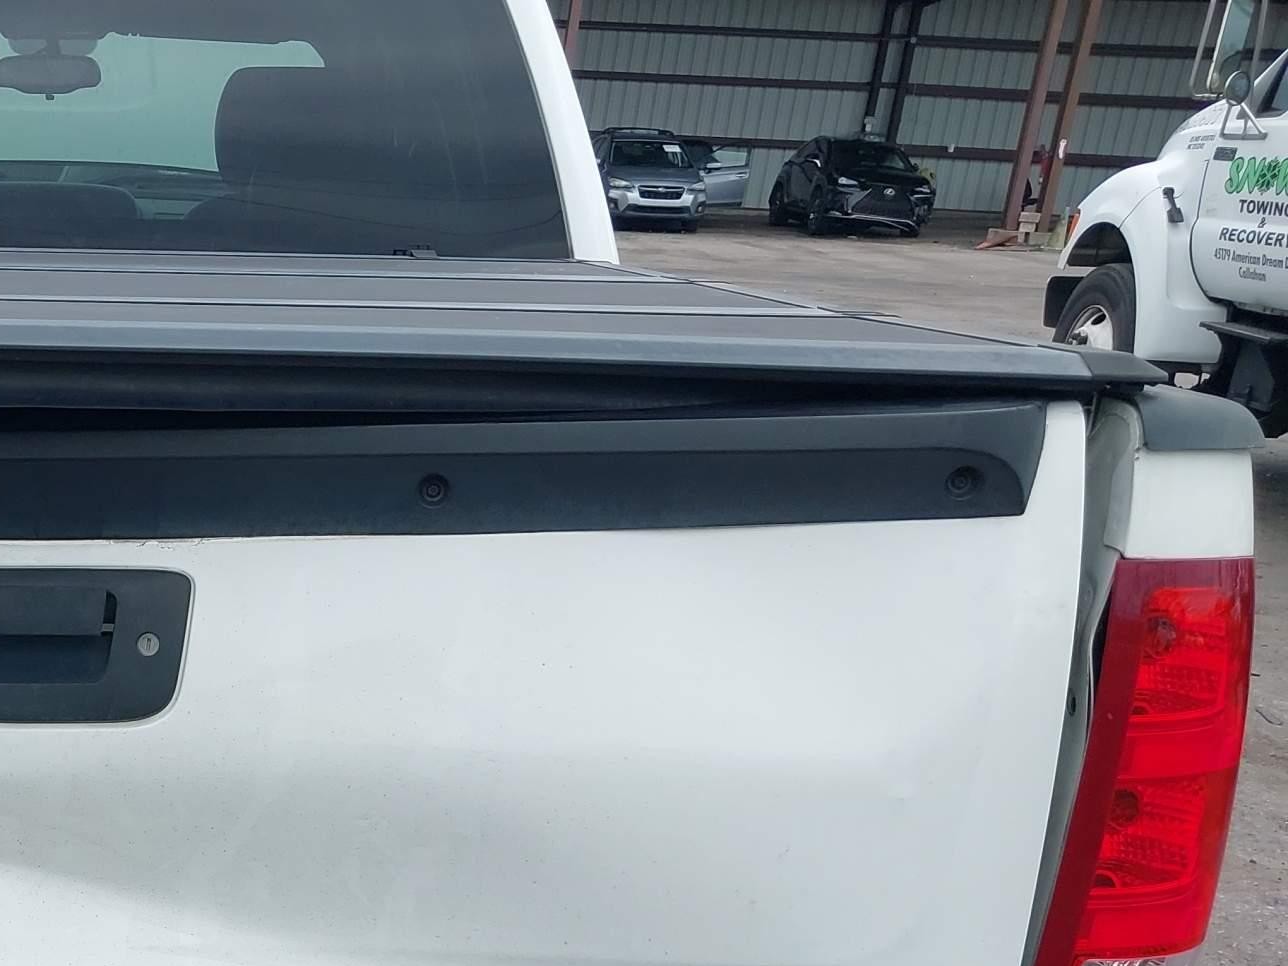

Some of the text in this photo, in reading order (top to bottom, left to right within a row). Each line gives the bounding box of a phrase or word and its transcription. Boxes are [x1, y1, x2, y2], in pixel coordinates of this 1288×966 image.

[1257, 216, 1267, 229] &
[1232, 249, 1261, 266] American
[1262, 254, 1284, 269] Dream
